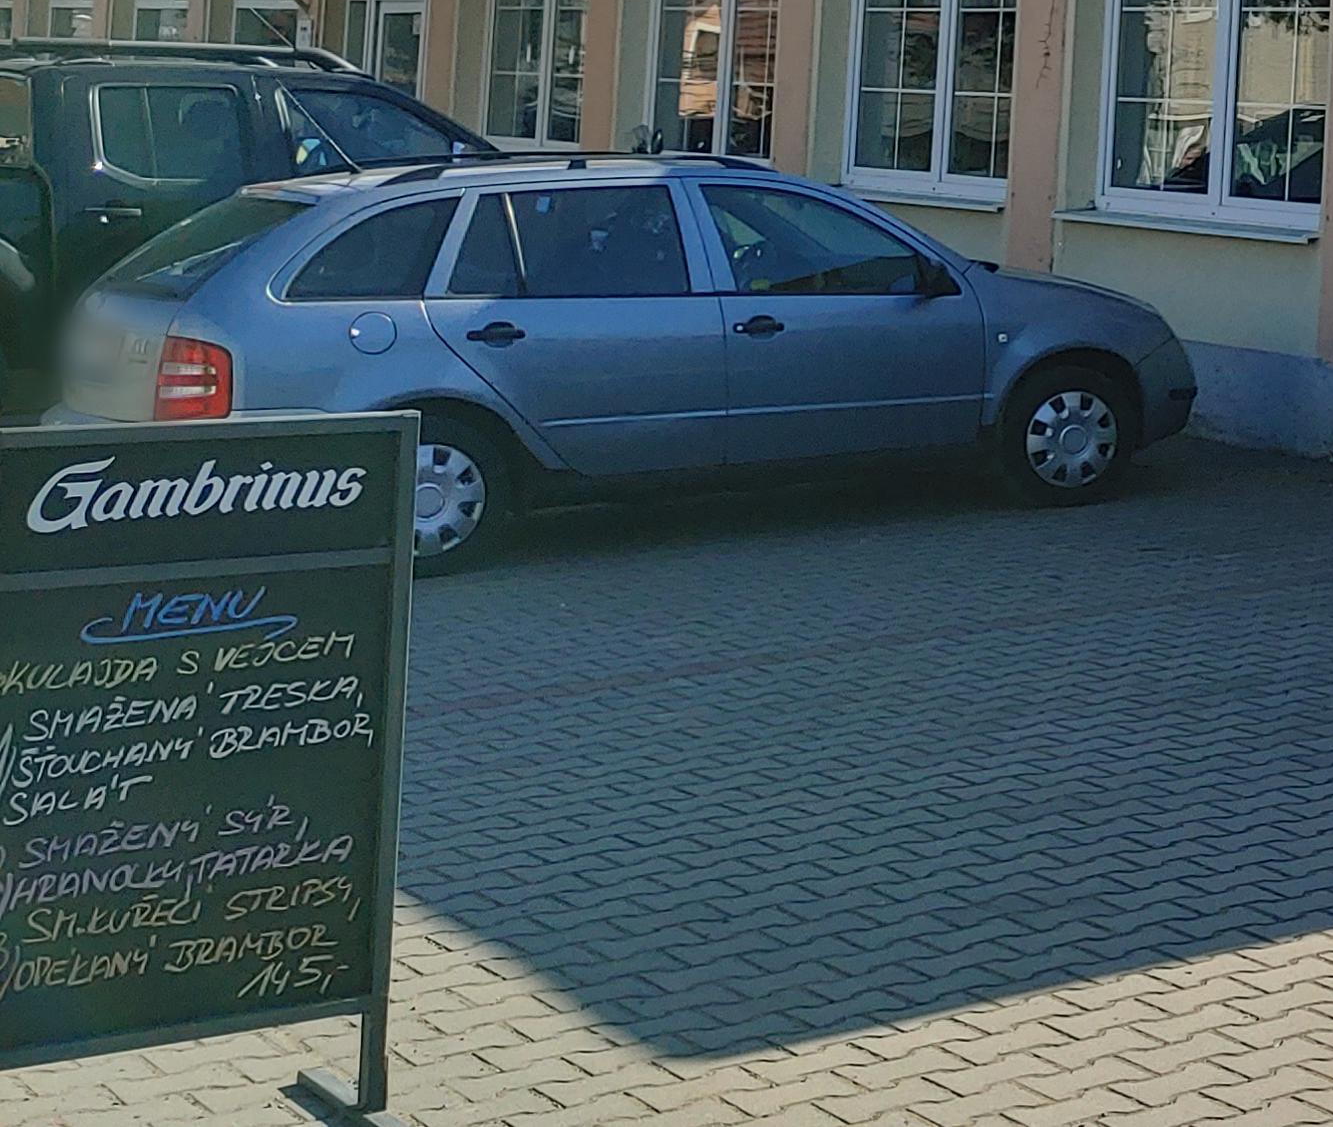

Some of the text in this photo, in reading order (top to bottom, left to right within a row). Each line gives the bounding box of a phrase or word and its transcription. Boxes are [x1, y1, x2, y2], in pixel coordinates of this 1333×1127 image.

[26, 455, 367, 534] Gambrinus
[121, 585, 266, 636] MENU
[1, 658, 158, 695] KULAJDA
[176, 650, 200, 674] S
[214, 631, 355, 672] VEJCEM
[164, 924, 339, 972] BRAMBOR
